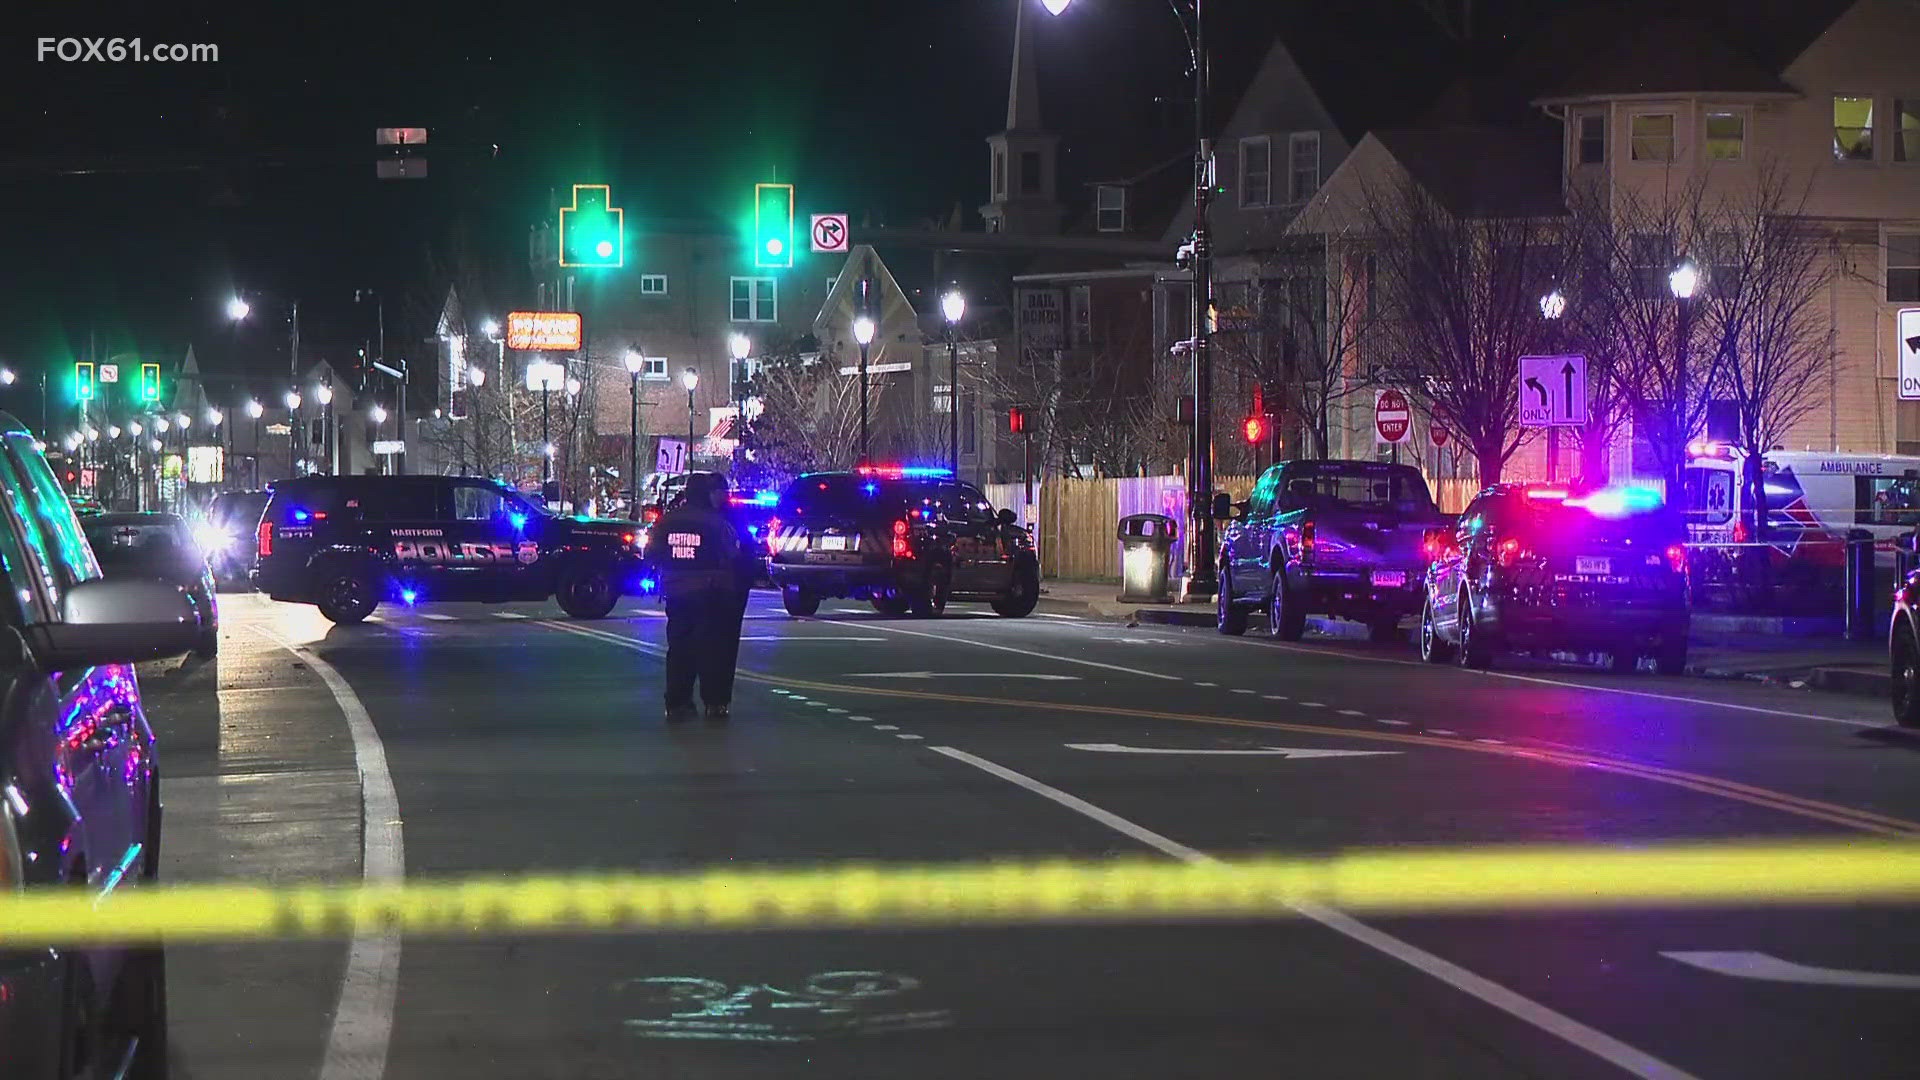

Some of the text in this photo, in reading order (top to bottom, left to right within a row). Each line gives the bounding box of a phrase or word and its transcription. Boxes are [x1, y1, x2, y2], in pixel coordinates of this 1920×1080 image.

[1380, 400, 1389, 409] DO
[1523, 409, 1551, 420] ONLY
[1382, 422, 1403, 433] ENTER
[1820, 461, 1883, 474] AMBULANCE
[390, 529, 443, 537] HARTFORD
[668, 533, 701, 546] HARTFORD
[394, 541, 513, 562] POLICE
[672, 546, 695, 558] POLICE
[1554, 575, 1630, 584] POLICE
